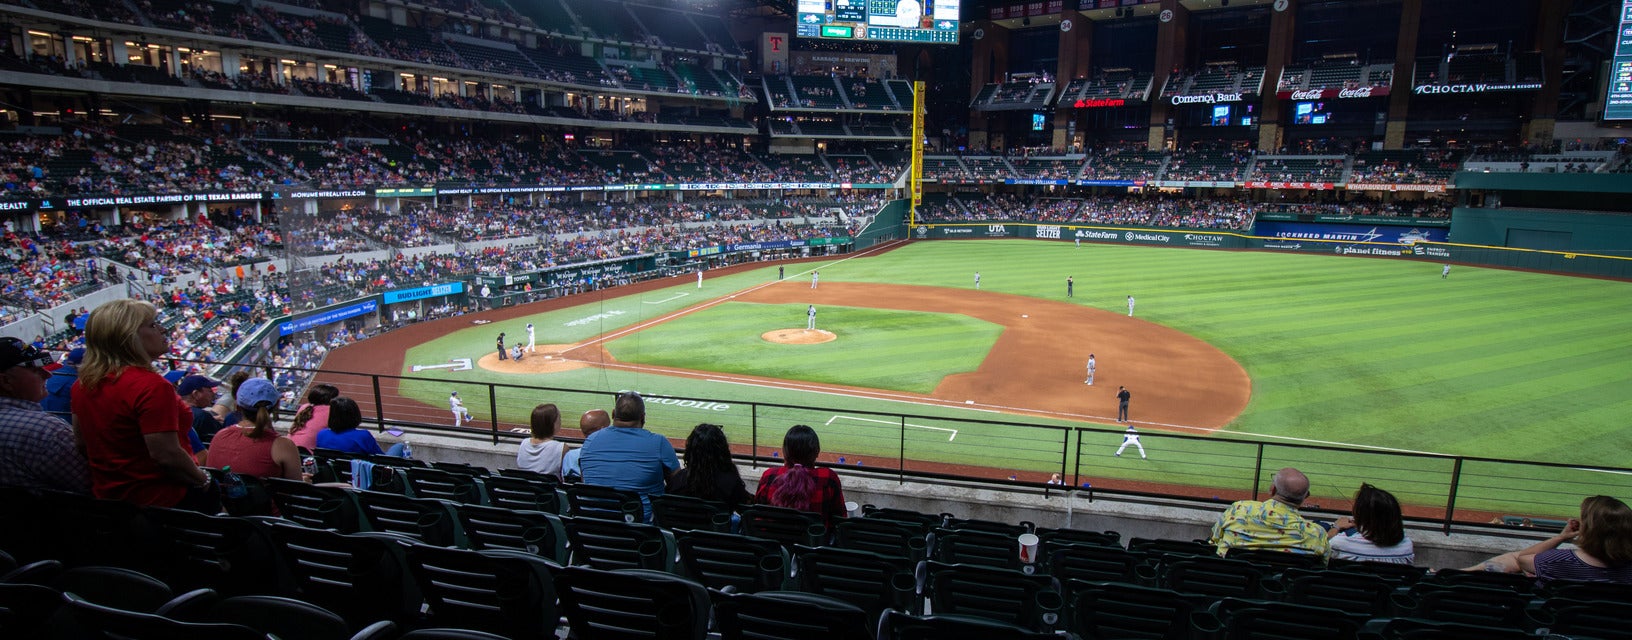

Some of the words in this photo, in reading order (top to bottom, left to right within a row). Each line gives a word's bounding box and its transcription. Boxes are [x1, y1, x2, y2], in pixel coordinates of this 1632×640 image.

[1161, 12, 1171, 20] 26
[1062, 22, 1071, 30] 34
[769, 36, 783, 52] T
[1422, 84, 1487, 94] CHOCTAW
[1216, 92, 1243, 102] Bank
[67, 199, 81, 207] THE
[82, 198, 115, 206] OFFICIAL
[134, 196, 155, 204] ESTATE
[156, 194, 182, 202] PARTNER
[231, 192, 262, 200] RANGERS
[988, 225, 1005, 233] UTA
[1035, 229, 1061, 239] SELTZER
[1135, 233, 1157, 241] Medical
[1189, 233, 1223, 241] CHOCTAW
[1276, 231, 1320, 239] LOCKHEED
[1323, 233, 1357, 241] MARTIN
[1343, 247, 1370, 256] planet
[1371, 247, 1401, 256] fitness
[412, 289, 432, 298] LIGHT
